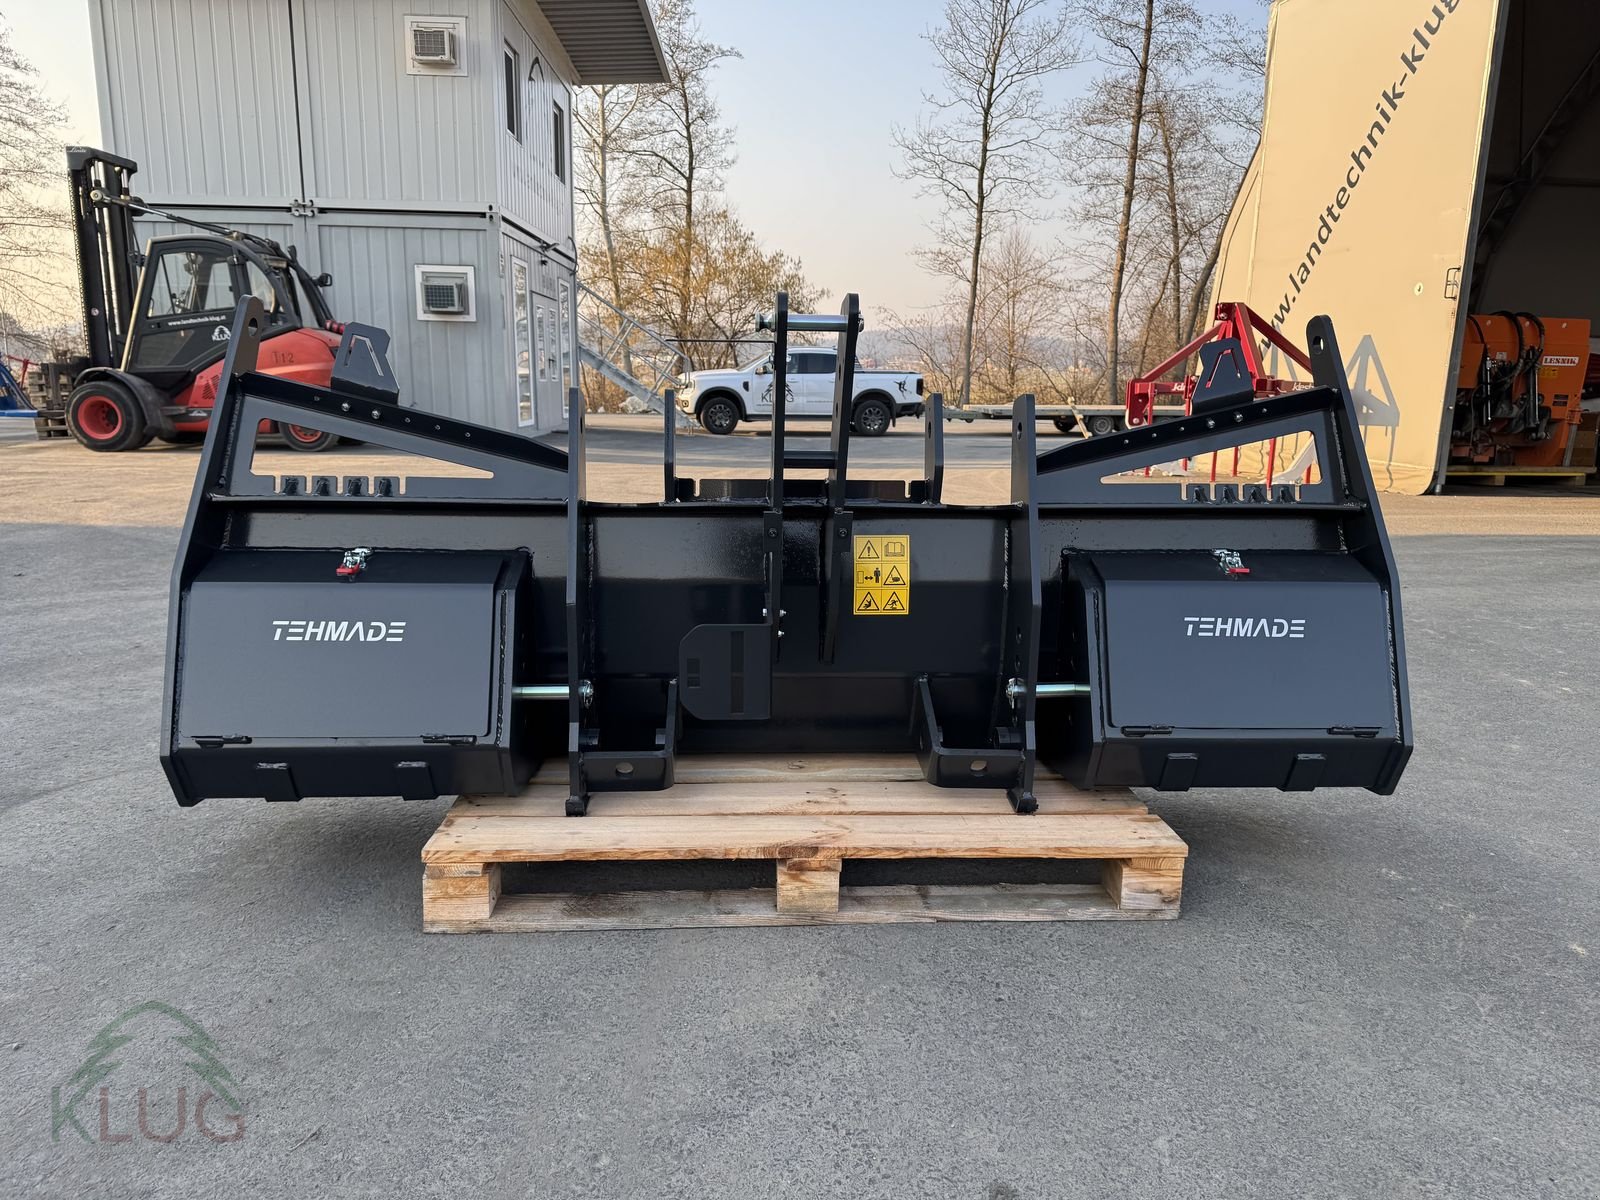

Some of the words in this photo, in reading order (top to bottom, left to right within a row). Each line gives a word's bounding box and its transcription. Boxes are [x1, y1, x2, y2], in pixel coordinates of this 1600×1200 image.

[761, 392, 795, 403] KLG
[272, 620, 407, 642] TEHMADE
[1184, 617, 1306, 638] TEHMADE
